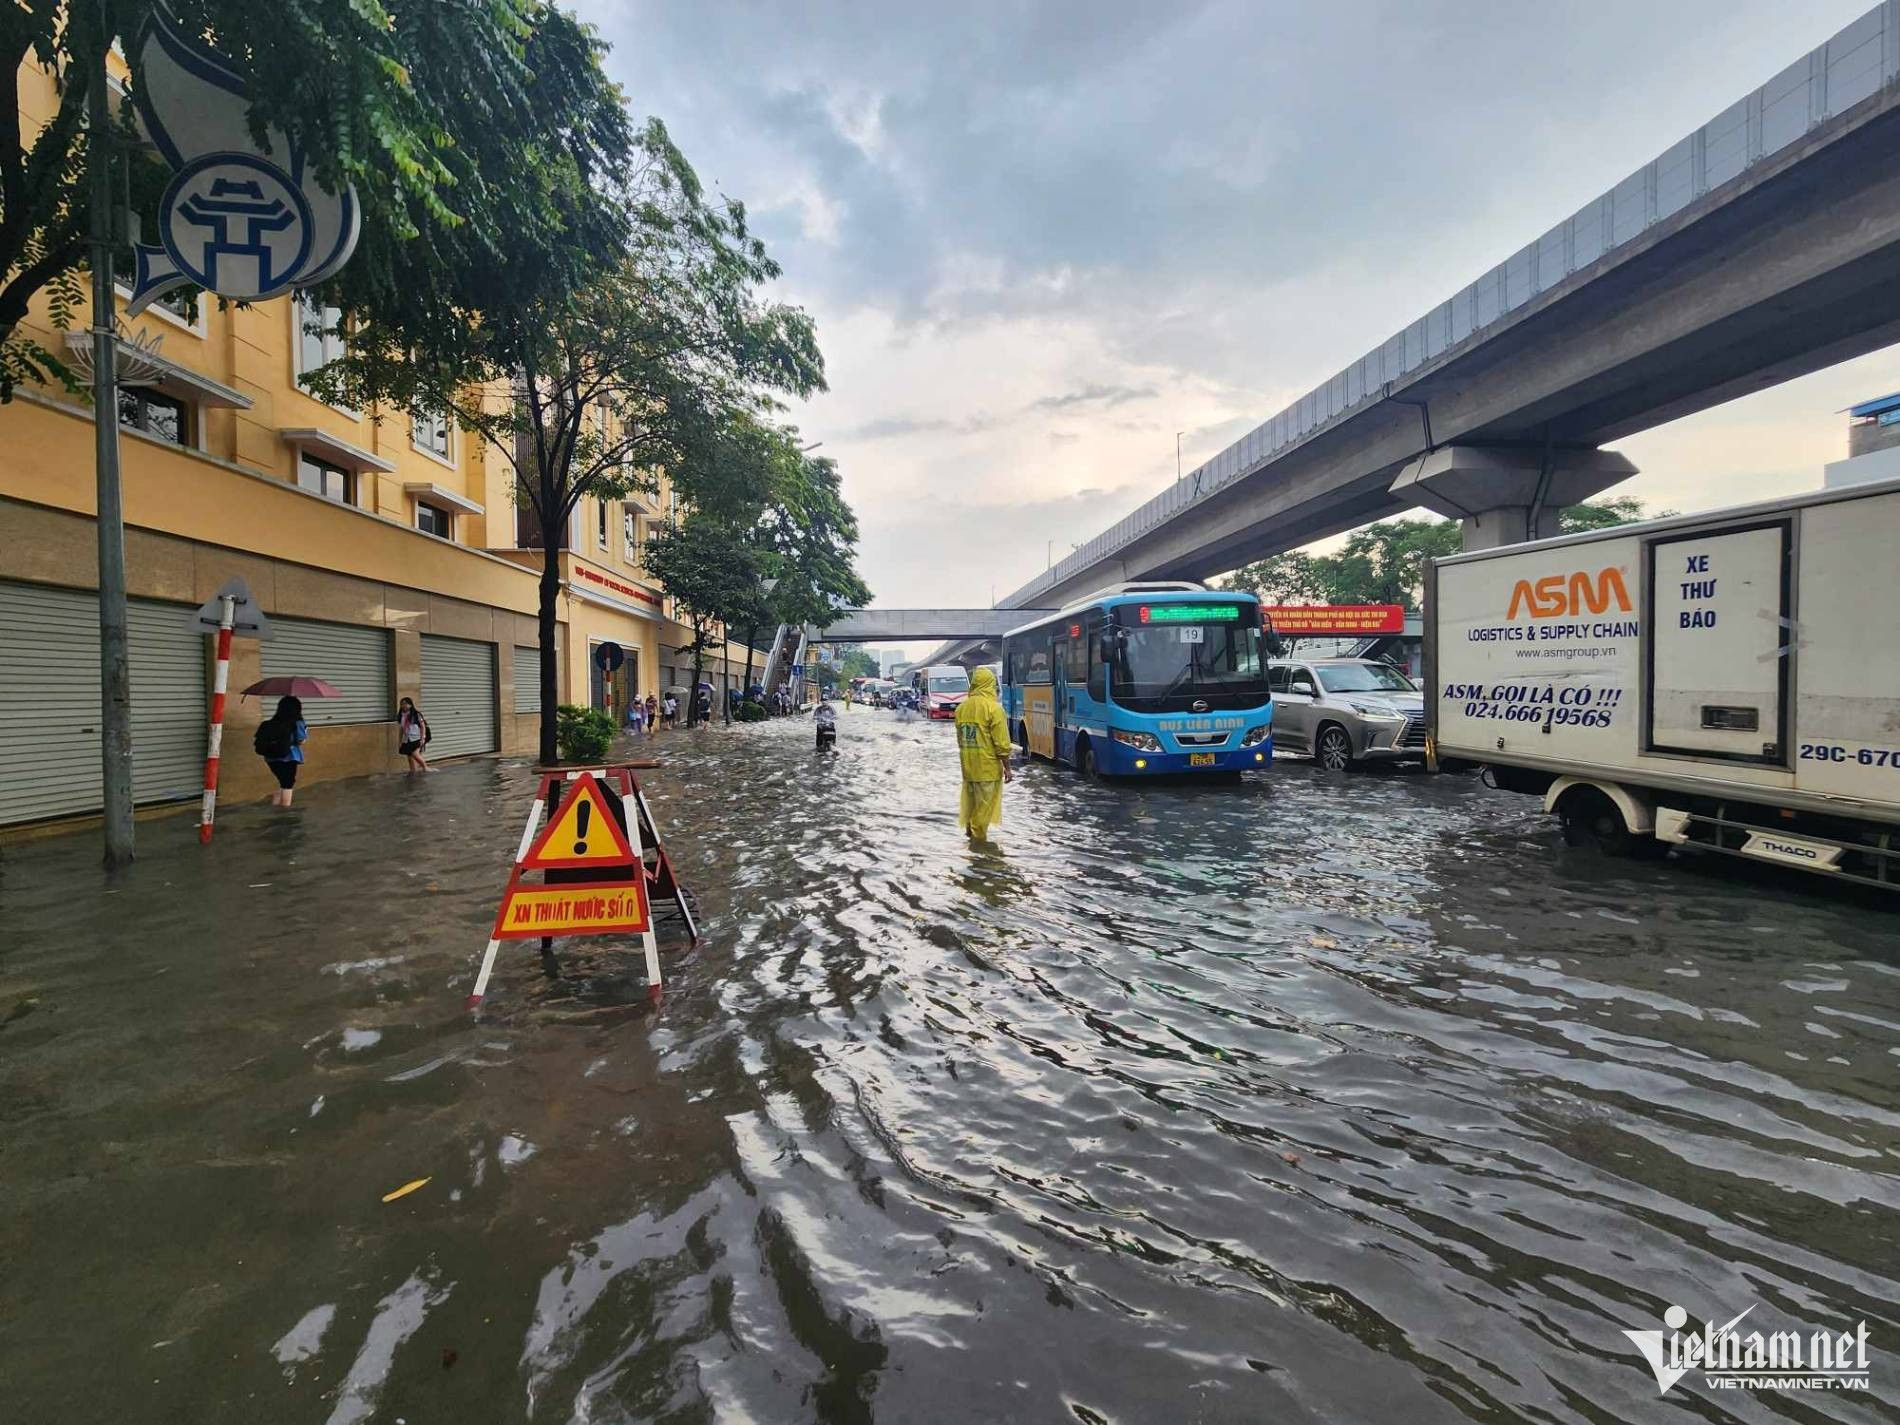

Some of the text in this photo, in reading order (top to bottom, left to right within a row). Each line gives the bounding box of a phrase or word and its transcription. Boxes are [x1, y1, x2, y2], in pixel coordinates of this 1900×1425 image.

[1686, 555, 1709, 574] XE
[1506, 567, 1633, 620] ASM
[1680, 578, 1718, 600] THƯ
[1680, 608, 1716, 629] BÁO
[1184, 629, 1198, 640] 19
[1468, 621, 1639, 641] LOGISTICS & SUPPLY CHAIN
[1516, 647, 1616, 660] www.asmgroup.vn
[1491, 685, 1527, 704] GỌI
[1529, 683, 1554, 704] LÀ
[1559, 684, 1592, 706] CÓ
[1596, 688, 1622, 708] !!!
[1159, 720, 1182, 731] BUS
[1763, 841, 1817, 859] THACO
[513, 903, 532, 923] XN
